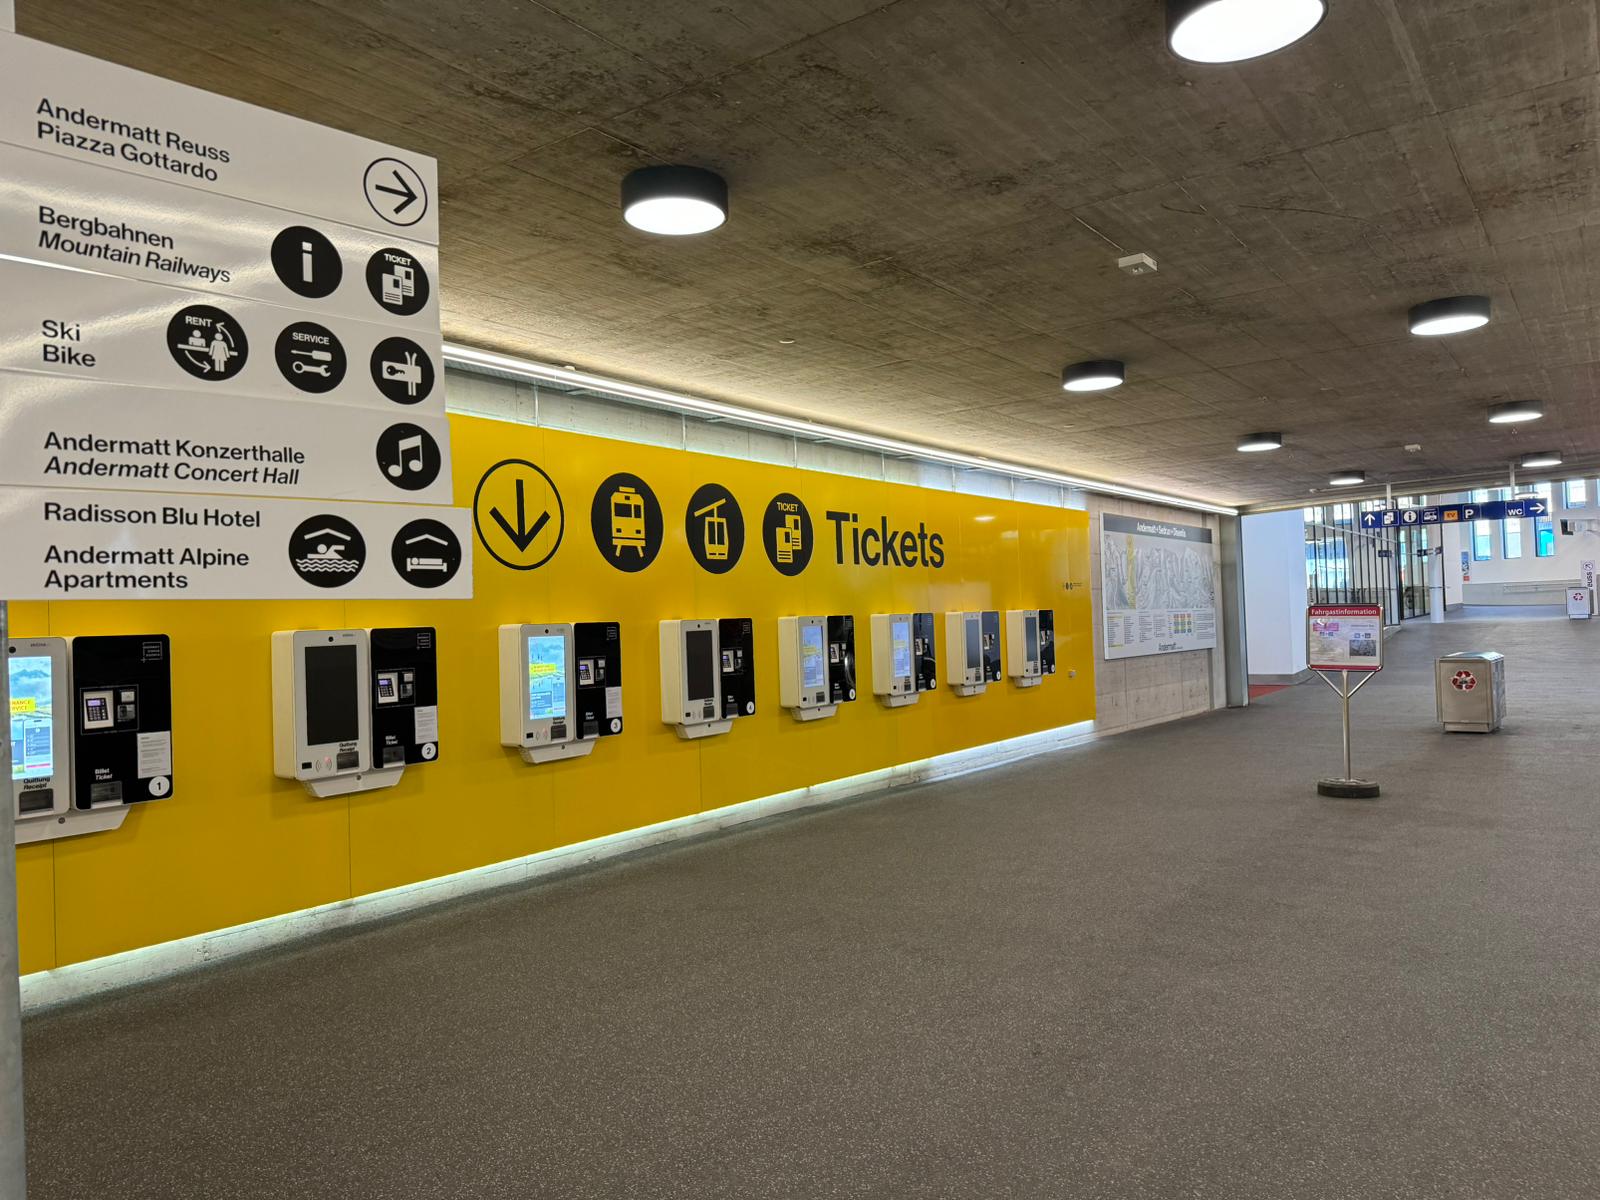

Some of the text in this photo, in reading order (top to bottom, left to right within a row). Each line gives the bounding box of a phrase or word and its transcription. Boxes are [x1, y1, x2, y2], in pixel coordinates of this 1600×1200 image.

[36, 98, 230, 163] Andermatt Reuss
[38, 121, 218, 182] Piazza Gottardo
[39, 206, 174, 249] Bergbahnen
[38, 230, 231, 283] Mountain Railways
[384, 253, 411, 266] TICKET
[42, 320, 80, 342] Ski
[185, 315, 213, 328] RENT
[292, 332, 330, 345] SERVICE
[42, 343, 96, 367] Bike
[44, 431, 305, 464] Andermatt Konzerthalle
[44, 456, 300, 485] Andermatt Concert Hall
[44, 502, 261, 527] Radisson Blu Hotel
[776, 501, 799, 512] TICKET
[1465, 509, 1474, 519] P
[1508, 508, 1523, 516] WC
[826, 510, 945, 568] Tickets
[44, 545, 250, 569] Andermatt Alpine
[44, 570, 188, 592] Apartments
[1311, 608, 1377, 617] Fahrgastinformation
[426, 747, 432, 755] 2
